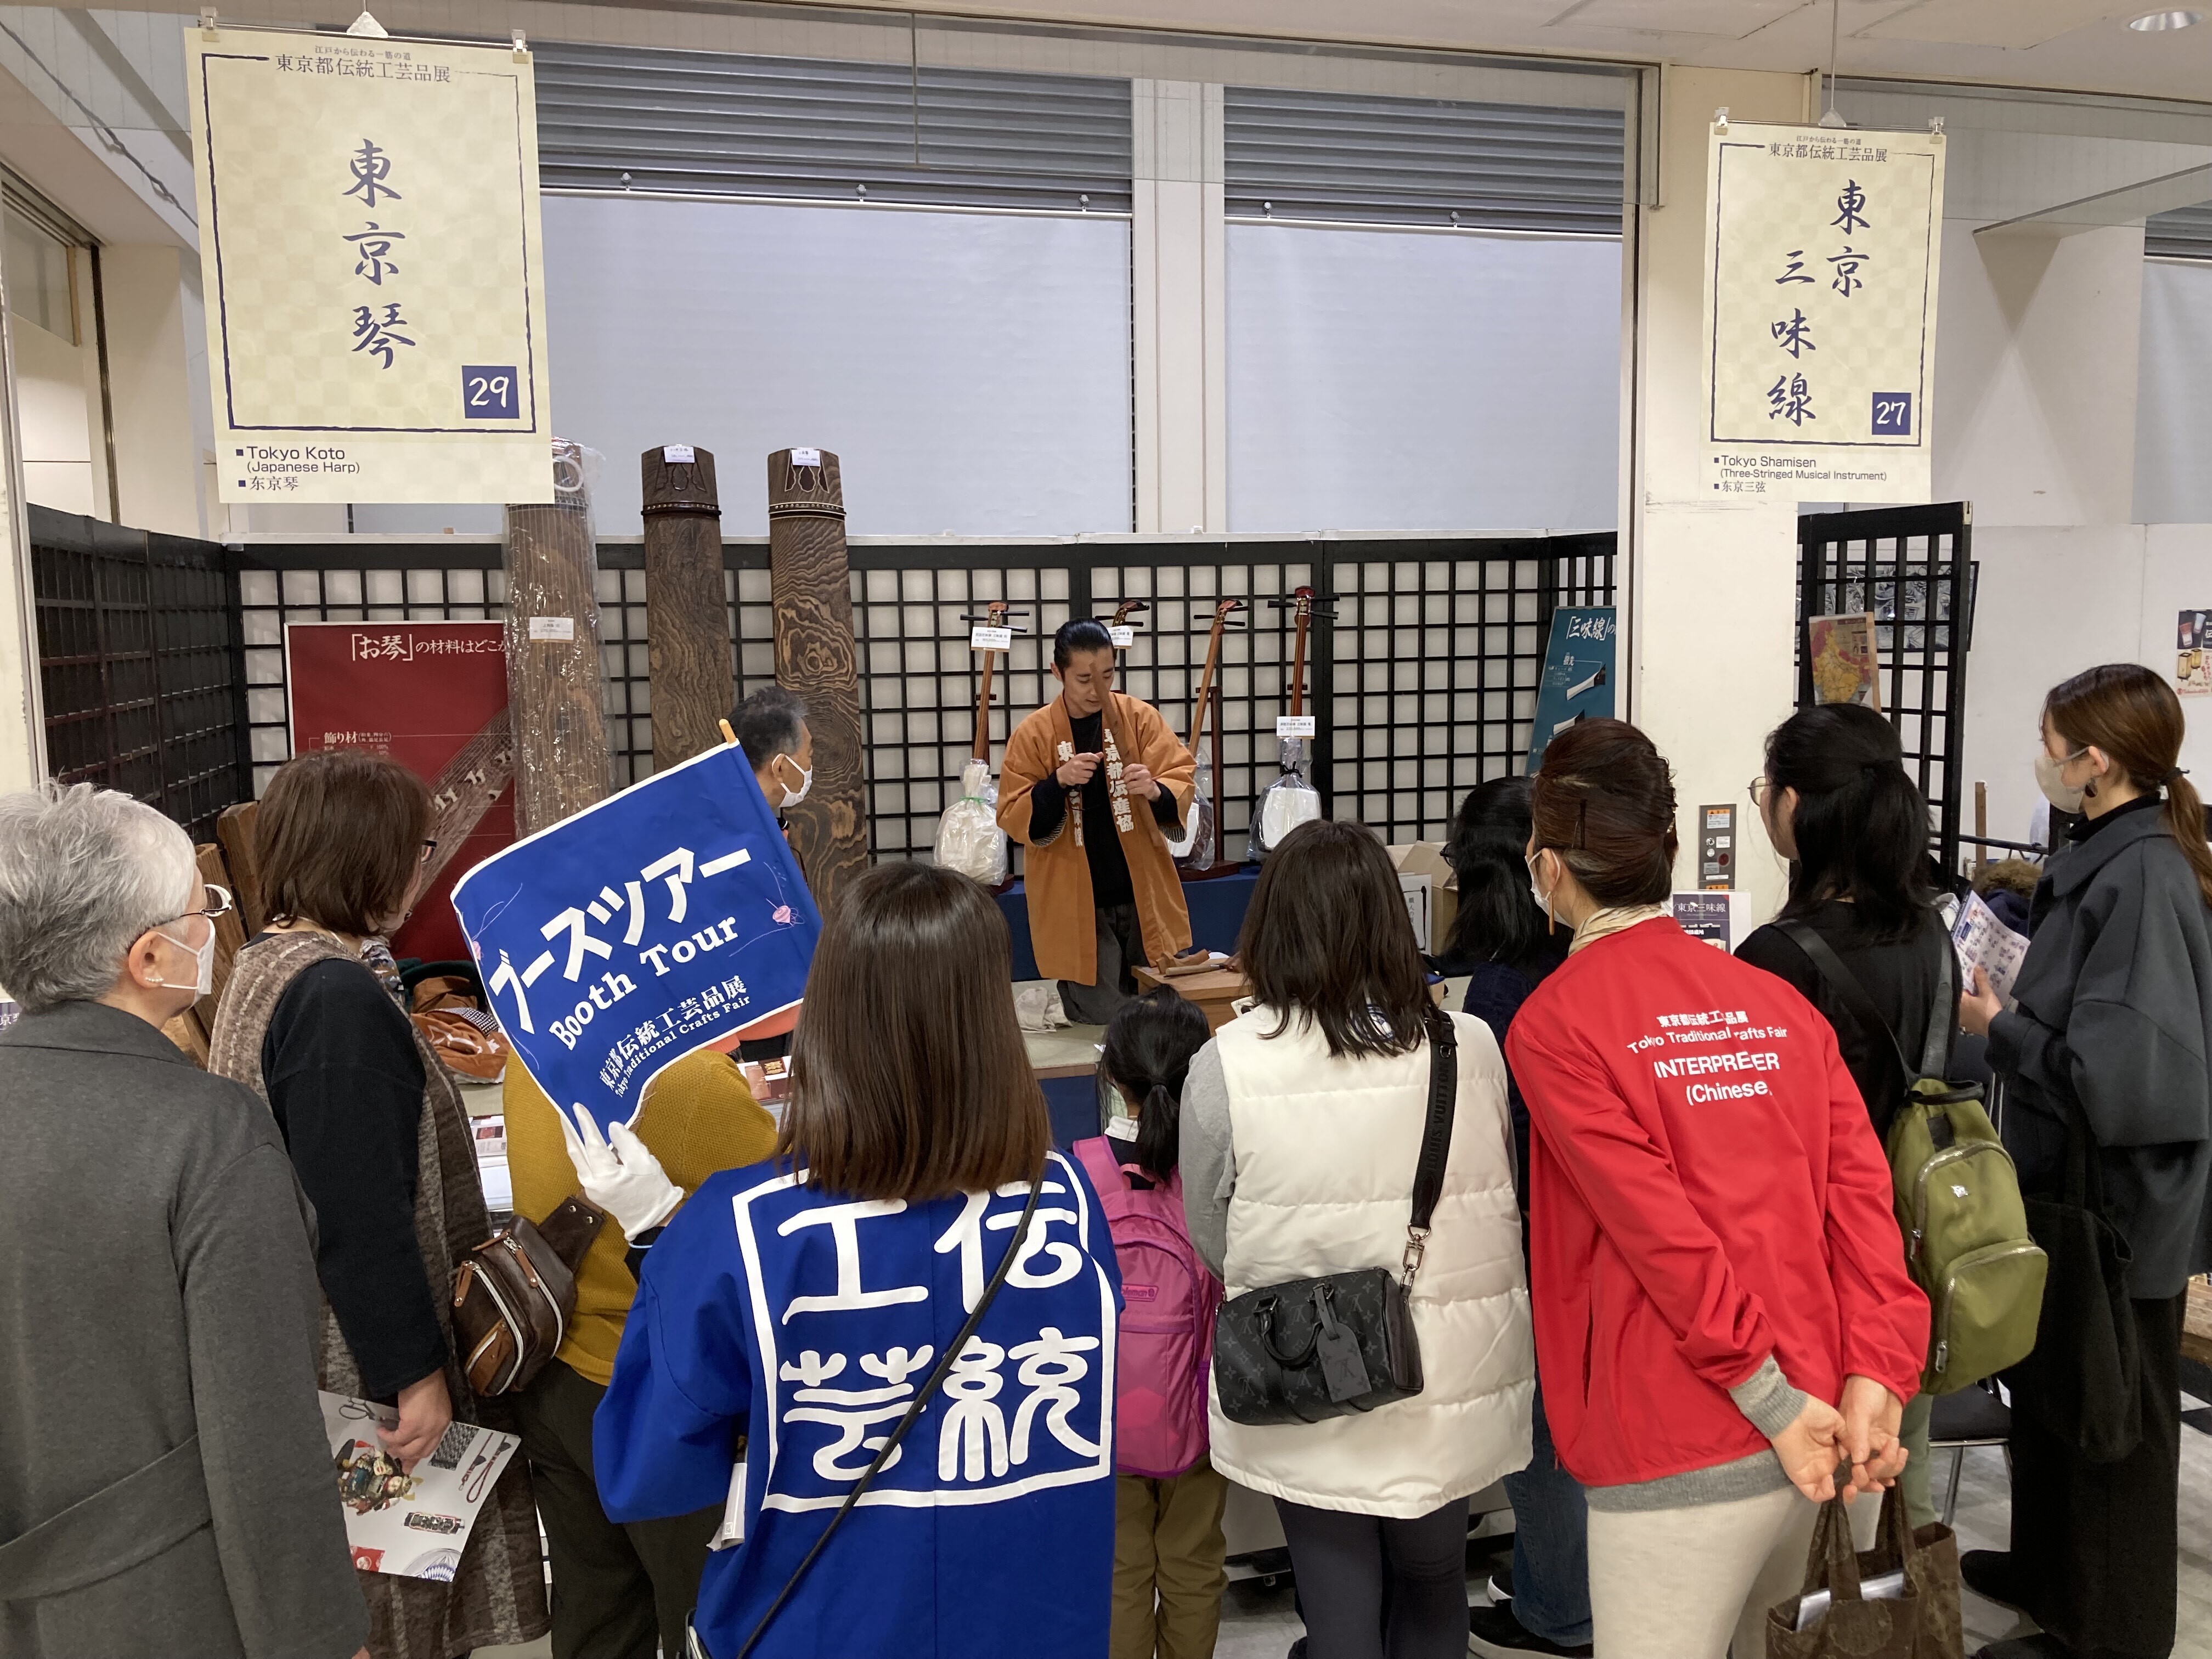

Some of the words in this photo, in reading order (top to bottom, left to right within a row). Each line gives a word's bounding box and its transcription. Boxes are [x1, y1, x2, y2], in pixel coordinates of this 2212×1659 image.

[315, 46, 411, 60] 江戸から伝わる一筋の道
[275, 54, 452, 83] 東京都伝統工芸品展
[1769, 142, 1887, 162] 東京都伝統工芸品展
[1826, 179, 1870, 297] 東京
[342, 138, 416, 370] 東京琴
[1766, 250, 1816, 427] 三味線
[469, 375, 509, 408] 29
[1876, 401, 1906, 426] 27
[246, 446, 300, 461] Tokyo
[306, 447, 345, 460] Koto
[1721, 455, 1756, 467] Tokyo
[1760, 456, 1816, 467] Shamisen
[247, 461, 319, 473] (Japanese
[323, 462, 360, 474] Harp)
[1720, 469, 1793, 479] (Three-Stringed
[1796, 470, 1831, 479] Musical
[1833, 471, 1887, 481] Instrument)
[249, 476, 299, 491] 东京琴
[1722, 481, 1766, 493] 东京三弦
[1566, 616, 1616, 641] 「三味線」の
[489, 847, 752, 1034] ブースツアー
[549, 972, 637, 1051] Booth
[640, 916, 738, 977] Tour
[1656, 1010, 1748, 1028] 東京都伝統工品展
[599, 975, 747, 1091] 東京都伝統工芸品展
[1666, 1026, 1732, 1043] Traditional
[1733, 1027, 1765, 1041] rafts
[1767, 1026, 1787, 1038] Fair
[614, 1076, 629, 1098] Tokyo
[679, 1012, 720, 1034] Crafts
[722, 996, 750, 1013] Fair
[1654, 1051, 1780, 1078] INTERPREER
[1686, 1080, 1773, 1106] (Chinese
